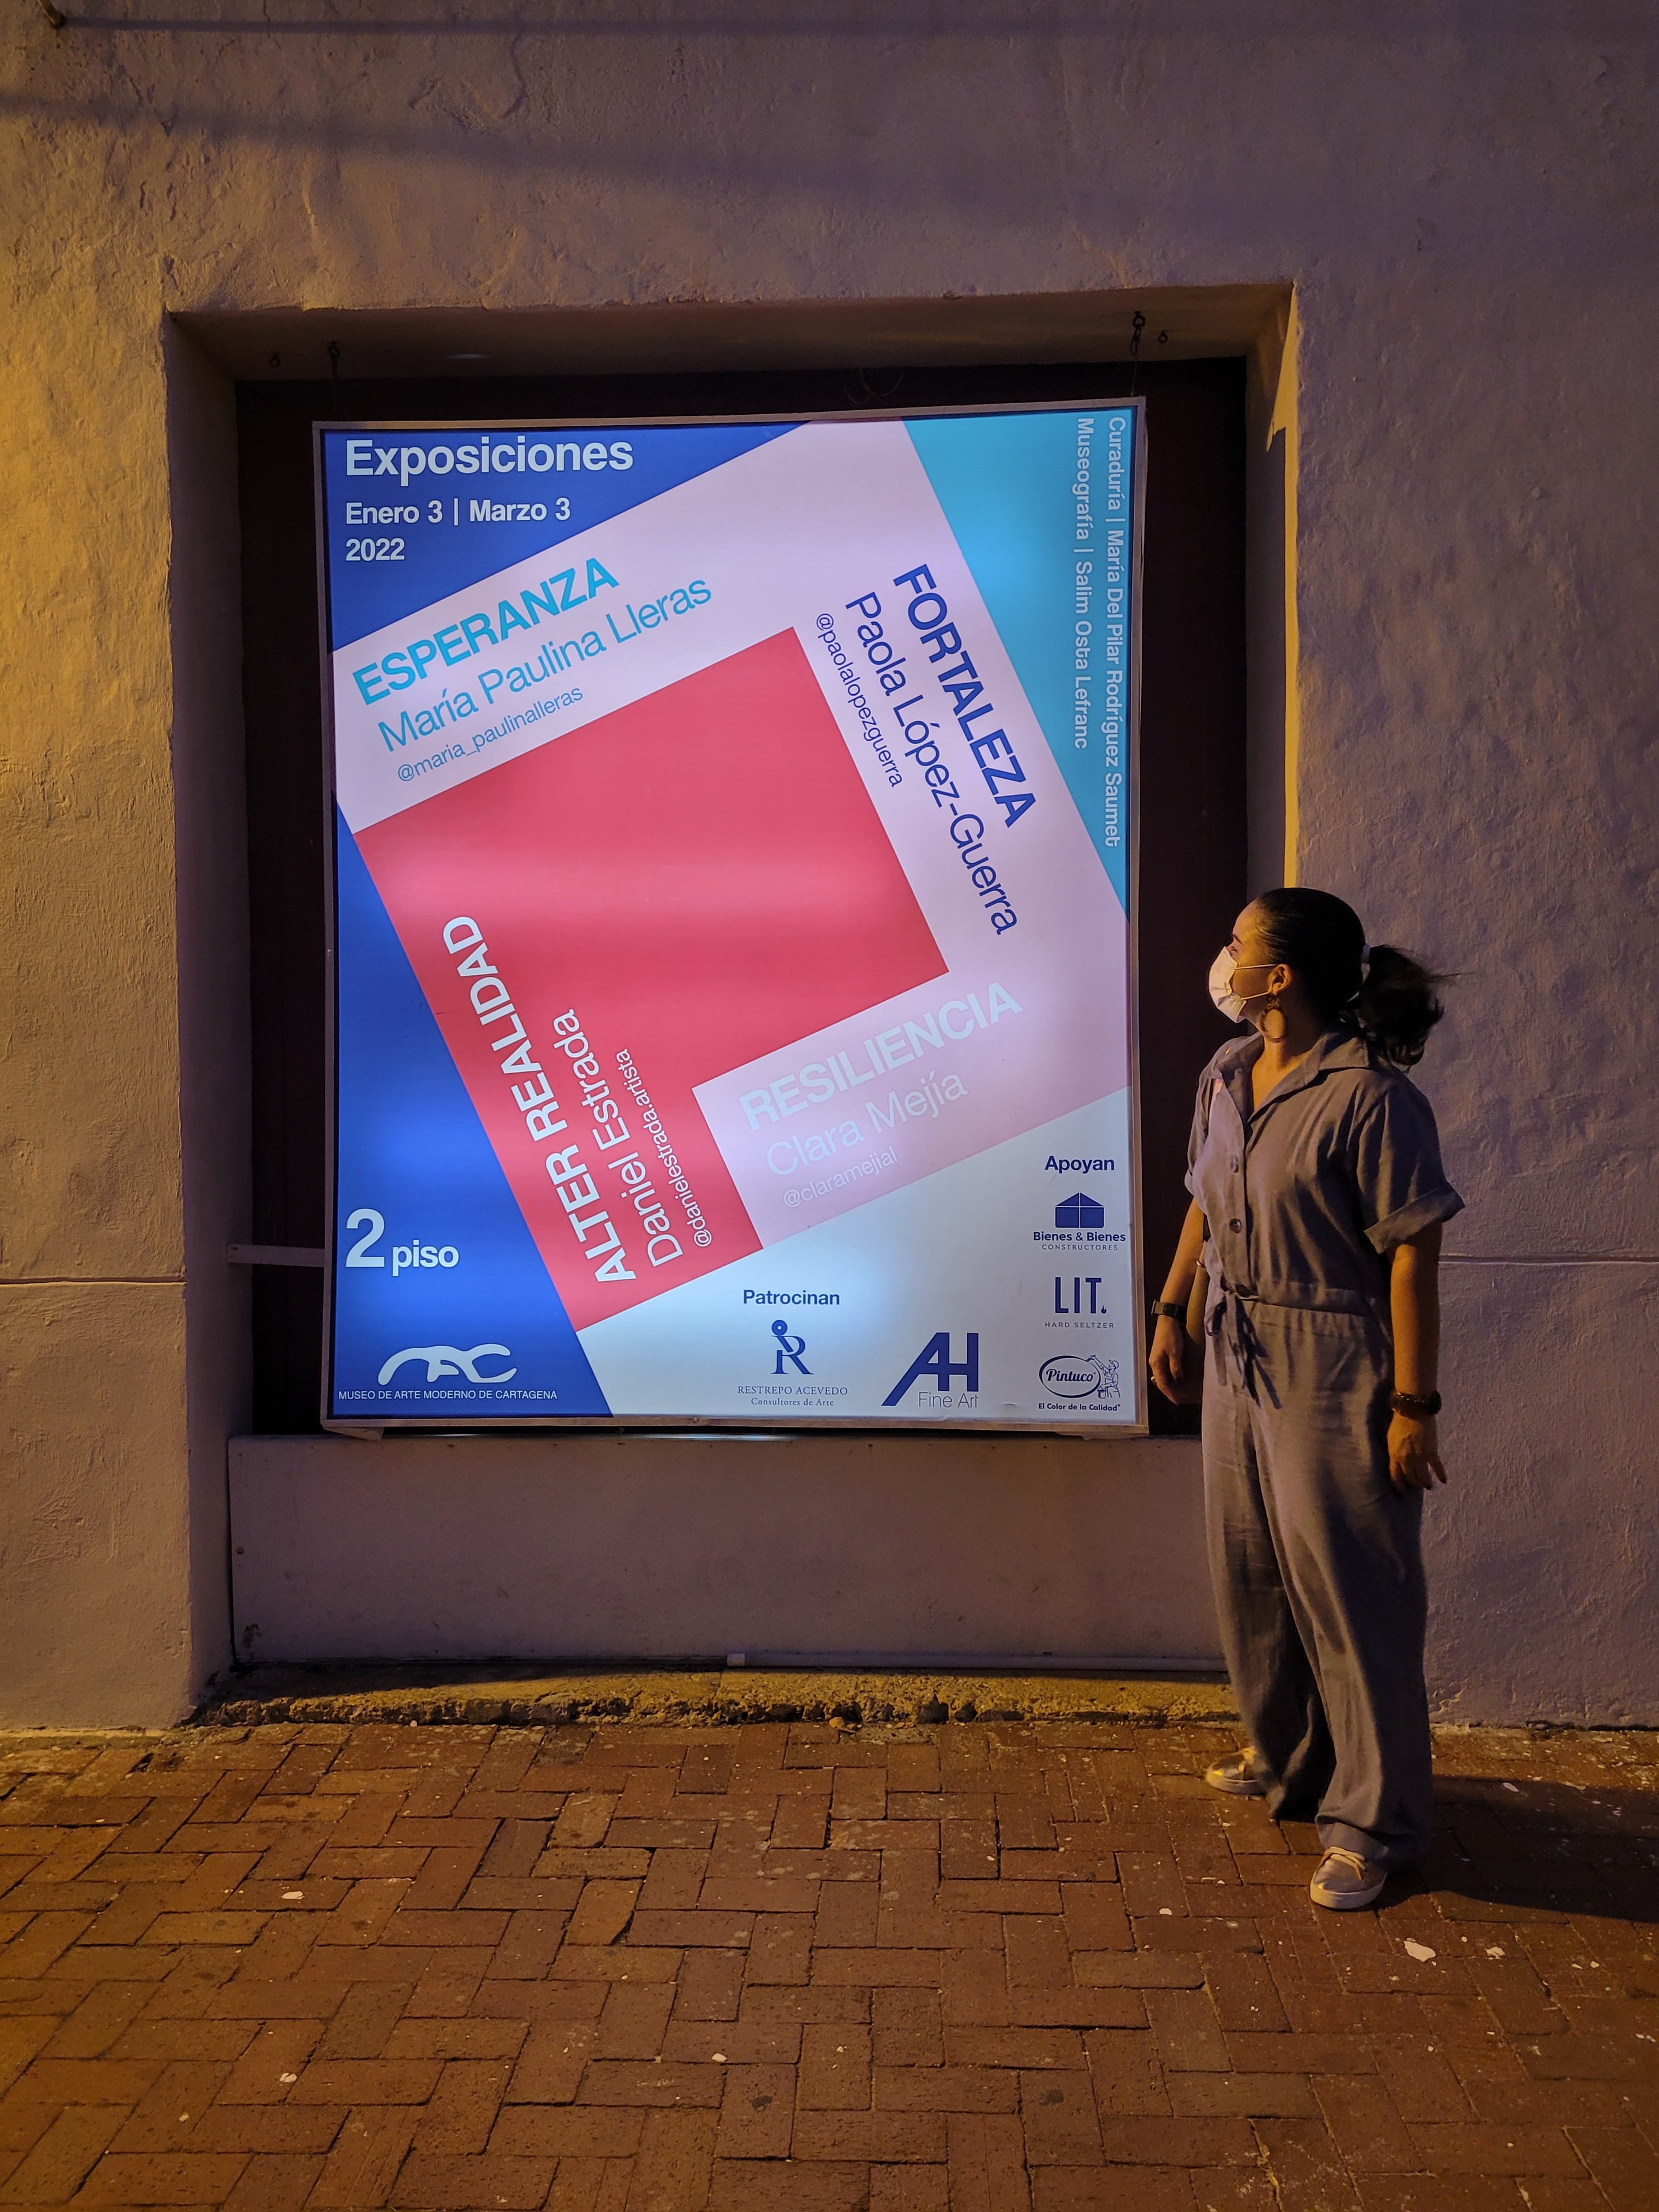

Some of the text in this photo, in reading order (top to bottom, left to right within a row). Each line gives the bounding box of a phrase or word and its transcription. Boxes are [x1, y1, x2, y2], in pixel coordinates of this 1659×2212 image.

[346, 435, 634, 487] Exposiciones
[1072, 418, 1094, 540] Museografía
[1108, 416, 1126, 510] Curaduría
[346, 502, 420, 525] Enero
[428, 500, 443, 524] 3
[469, 499, 548, 522] Marzo
[555, 497, 571, 521] 3
[346, 539, 405, 561] 2022
[1107, 530, 1124, 583] María
[1075, 560, 1093, 614] Salim
[1107, 587, 1123, 619] Del
[352, 558, 620, 705] ESPERANZA
[378, 579, 712, 752] María Paulina Lleras
[1074, 620, 1092, 670] Osta
[1106, 624, 1123, 665] Pilar
[816, 613, 903, 787] @paolalopezguerra
[893, 563, 1036, 828] FORTALEZA
[1074, 676, 1092, 749] Lefranc
[1101, 670, 1123, 767] Rodríguez
[397, 687, 584, 782] @maria_paulinalleras
[845, 591, 1017, 935] Paola López-Guerra
[1105, 772, 1122, 847] Saumet
[738, 982, 1024, 1131] RESILIENCIA
[442, 916, 637, 1282] ALTER REALIDAD
[767, 1070, 968, 1176] Clara Mejía
[553, 1008, 683, 1267] Daniel Estrada
[616, 1048, 712, 1247] @danielestrada.artista
[1044, 1155, 1115, 1174] Apoyan
[346, 1208, 460, 1277] 2 piso
[1033, 1232, 1126, 1242] Bienes & Bienes
[743, 1289, 840, 1305] Patrocinan
[338, 1390, 558, 1400] MUSEO DE ARTE MODERNO DE CARTAGENA
[737, 1386, 849, 1396] RESTREPO ACEVEDO
[751, 1398, 801, 1406] Consultores
[804, 1398, 813, 1406] de
[918, 1392, 979, 1408] Fine Art
[1067, 1403, 1077, 1411] de
